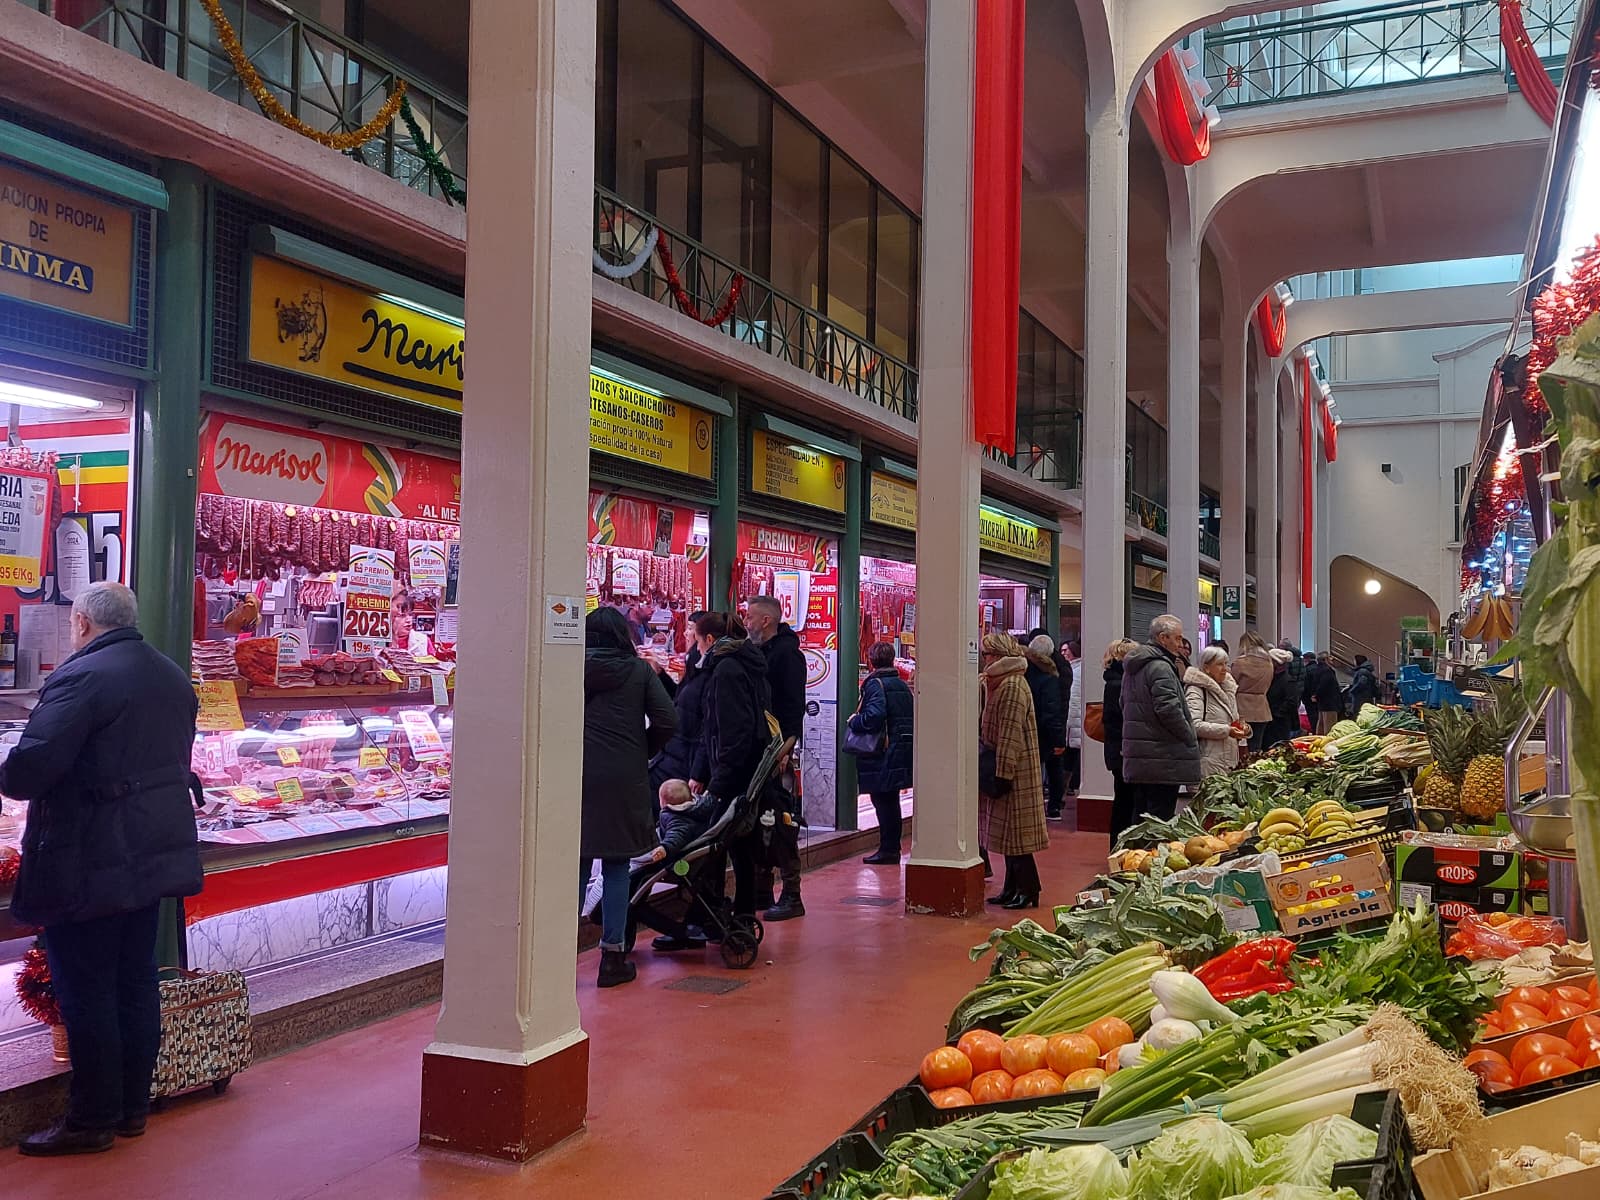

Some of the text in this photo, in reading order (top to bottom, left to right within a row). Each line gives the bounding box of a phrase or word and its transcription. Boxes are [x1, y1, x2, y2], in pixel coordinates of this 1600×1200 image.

[29, 220, 48, 242] DE
[56, 202, 106, 236] PROPIA
[619, 387, 676, 418] SALCHICHONES
[629, 442, 638, 453] de
[634, 429, 651, 442] 100%
[215, 437, 325, 485] Marisol
[757, 528, 796, 553] PREMIO
[1007, 522, 1035, 550] INMA
[345, 610, 390, 638] 2025
[1439, 865, 1476, 880] TROPS
[1306, 883, 1355, 902] Aloa
[1297, 901, 1381, 929] Agricola
[1439, 904, 1476, 917] TROPS
